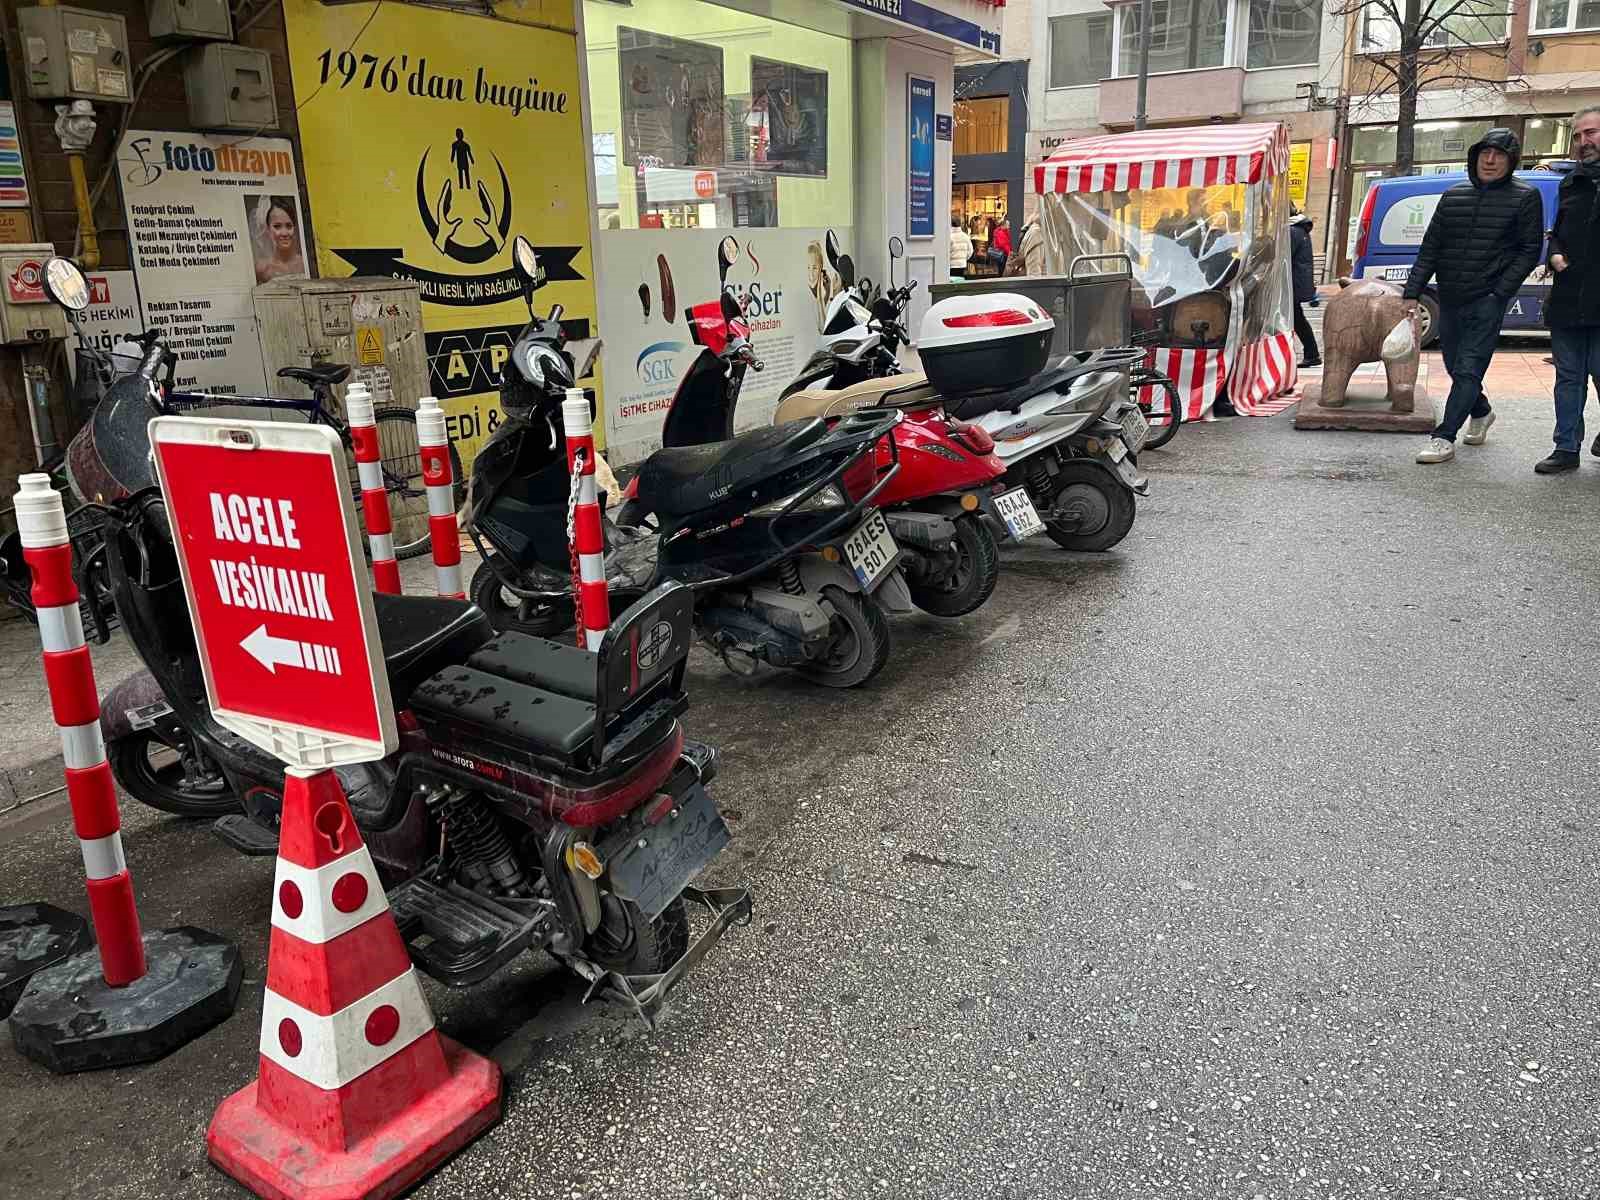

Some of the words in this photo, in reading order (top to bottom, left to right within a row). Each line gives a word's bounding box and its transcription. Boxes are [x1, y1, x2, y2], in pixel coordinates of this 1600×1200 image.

[318, 47, 467, 102] 1976'dan
[475, 67, 568, 116] bugüne
[163, 140, 293, 176] fotodizayn
[131, 204, 166, 215] Fotoğraf
[166, 204, 195, 216] Çekimi
[184, 217, 223, 229] Çekimleri
[159, 231, 199, 241] Mezuniyet
[200, 230, 237, 241] Çekimleri
[138, 245, 170, 255] Katalog
[176, 242, 196, 254] Ürün
[196, 243, 235, 255] Çekimleri
[140, 256, 158, 268] Özel
[158, 257, 181, 267] Moda
[182, 256, 220, 268] Çekimleri
[439, 281, 465, 298] NESİL
[466, 282, 483, 300] İÇİN
[485, 279, 522, 297] SAĞLIKLI
[90, 305, 135, 321] HEKİMİ
[147, 302, 178, 312] Reklam
[179, 301, 211, 310] Tasarım
[150, 315, 169, 325] Logo
[170, 314, 202, 323] Tasarım
[206, 336, 232, 347] Çekimi
[642, 358, 676, 384] SGK
[209, 492, 301, 549] ACELE
[1013, 511, 1032, 531] 962
[864, 543, 887, 573] 501
[209, 555, 334, 621] VESİKALIK
